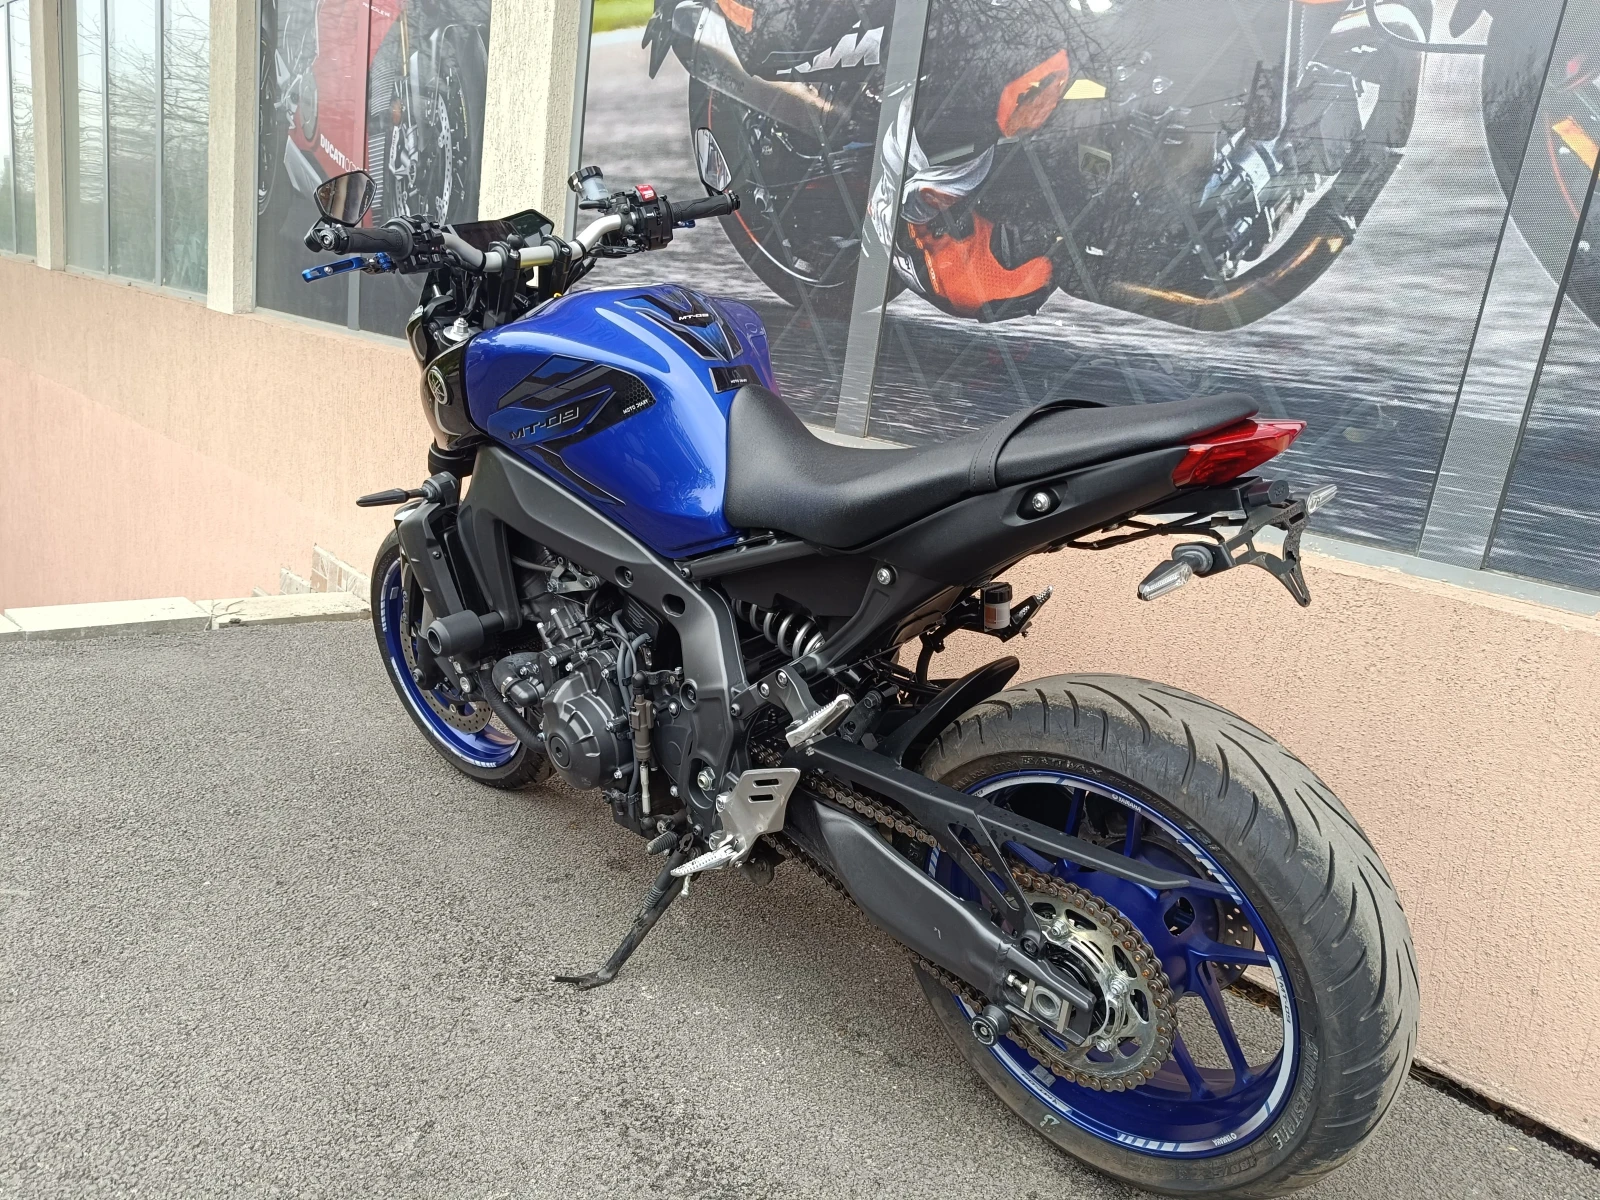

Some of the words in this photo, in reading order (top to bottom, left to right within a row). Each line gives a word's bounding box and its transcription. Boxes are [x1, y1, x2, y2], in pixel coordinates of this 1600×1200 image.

[320, 133, 346, 170] DUCATI
[622, 404, 636, 415] MOTO
[510, 406, 579, 441] MT-09
[1118, 796, 1142, 813] YAMAHA
